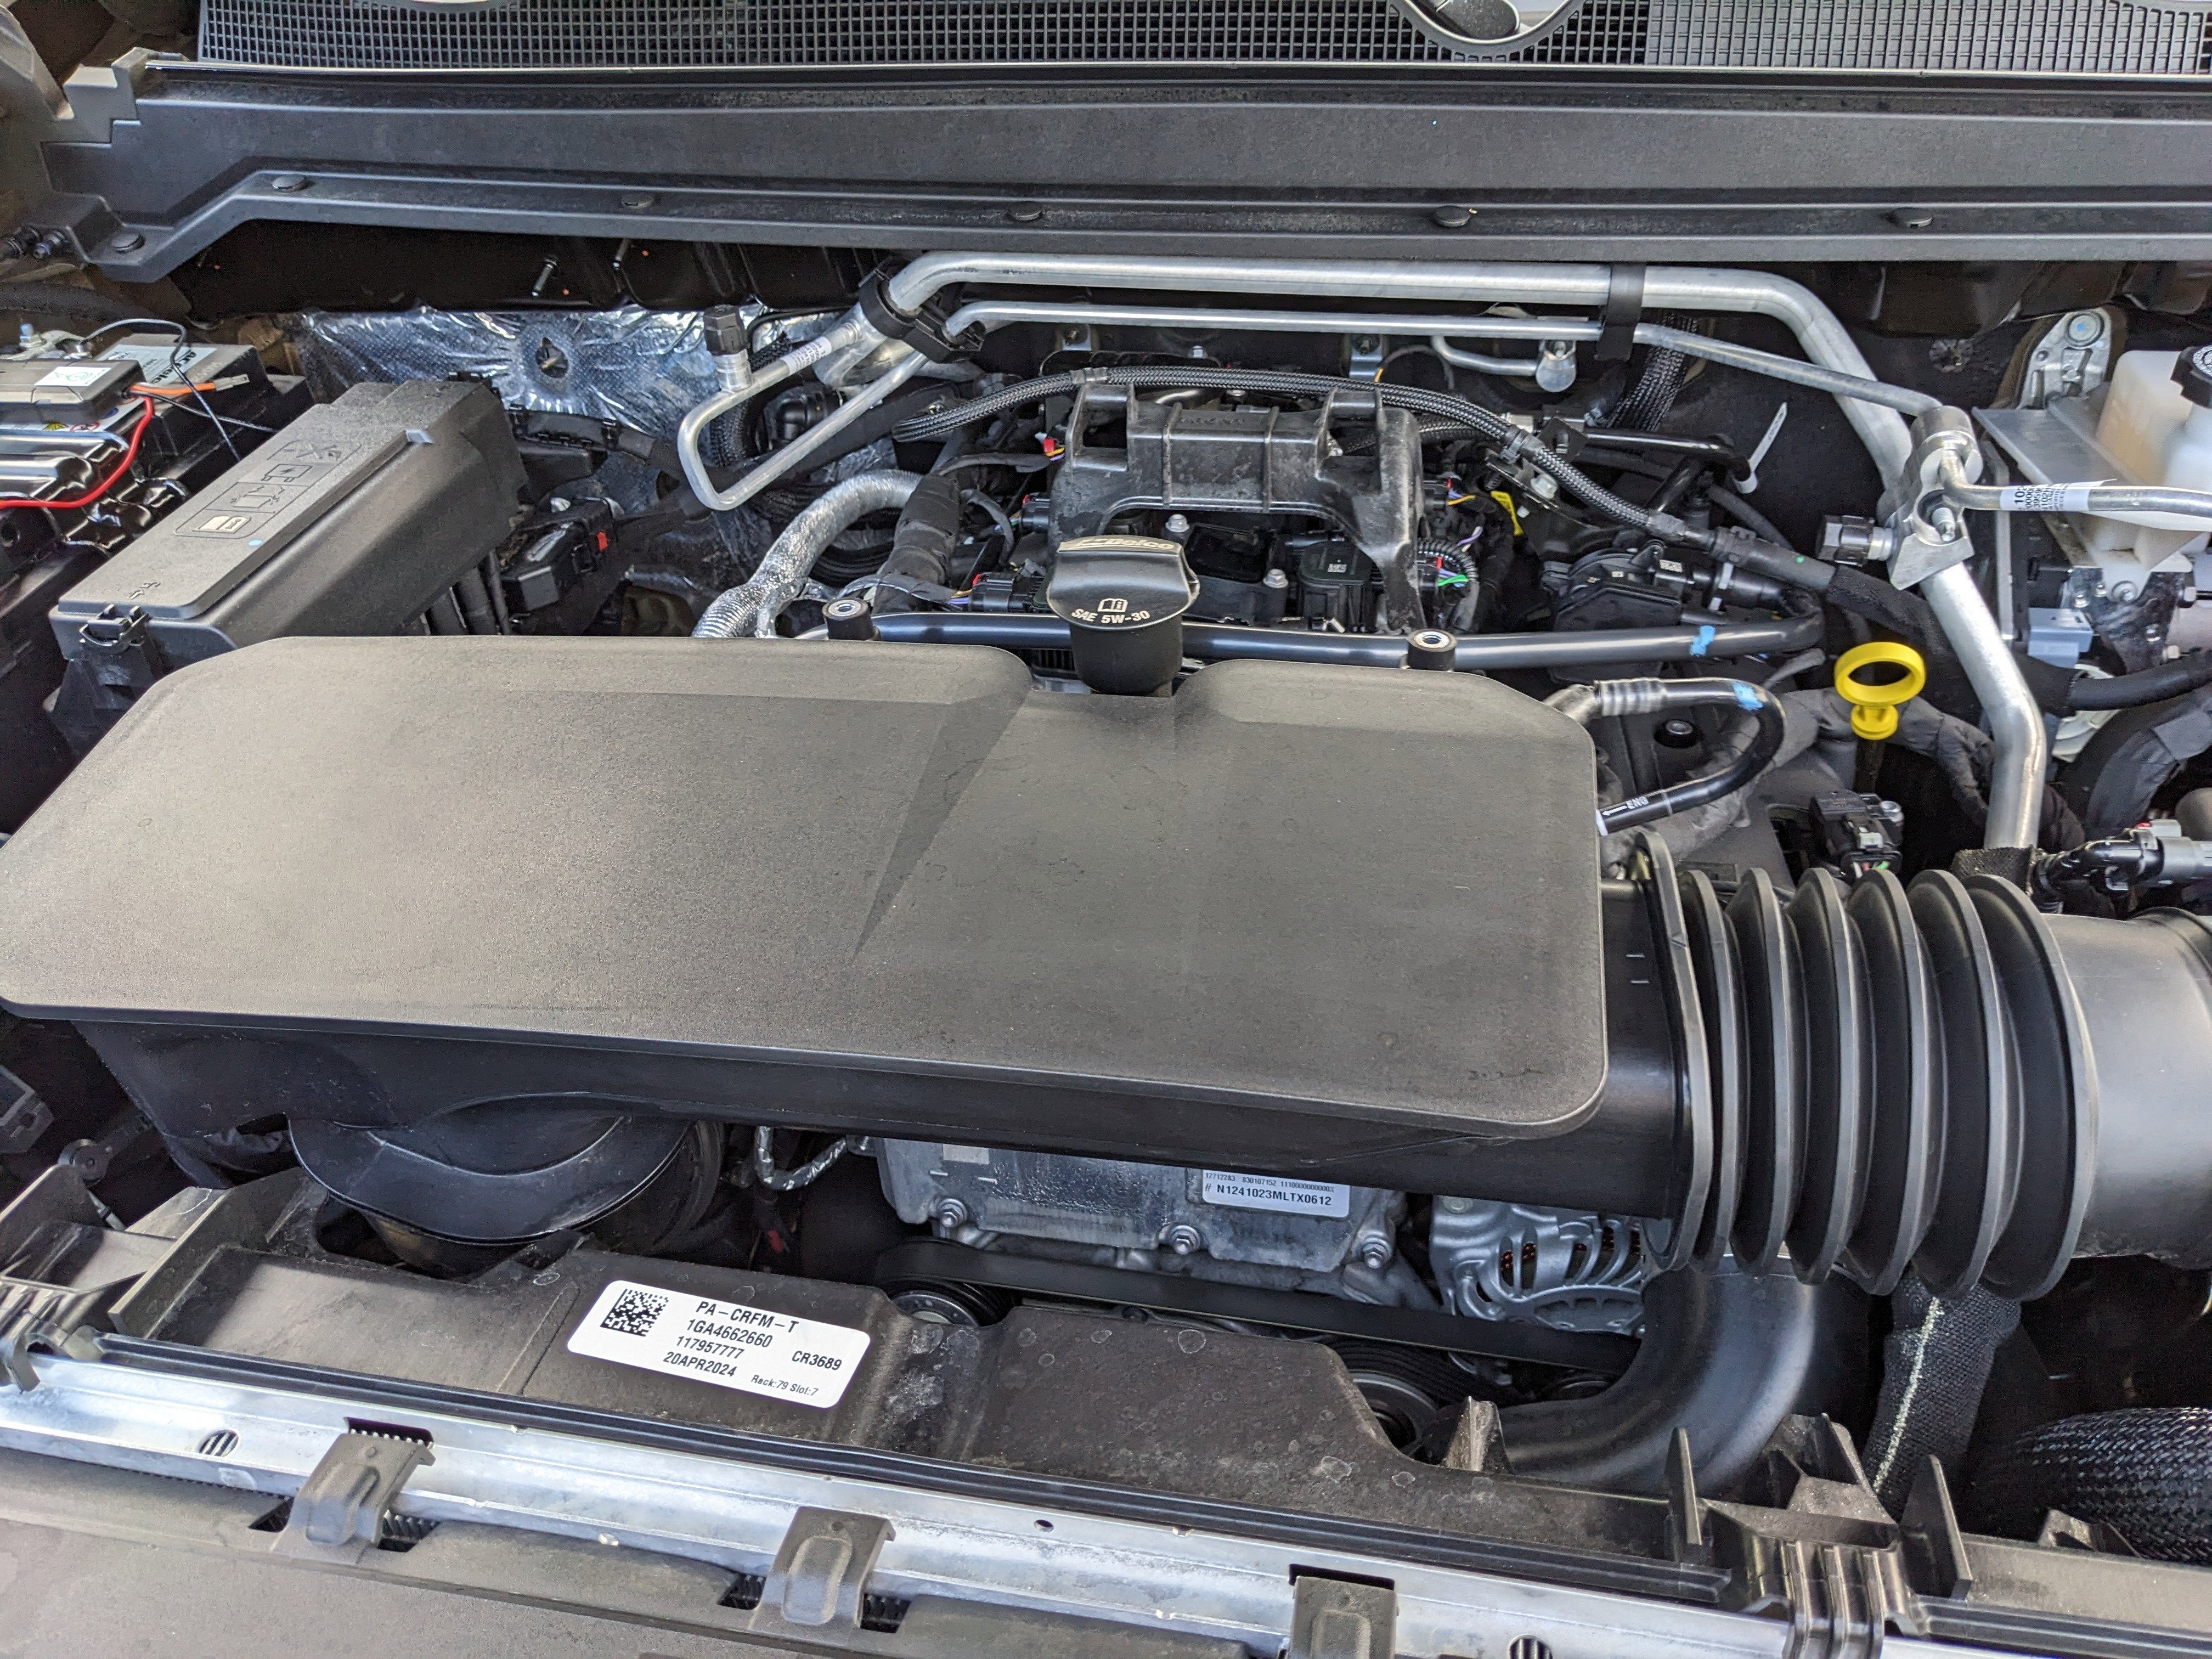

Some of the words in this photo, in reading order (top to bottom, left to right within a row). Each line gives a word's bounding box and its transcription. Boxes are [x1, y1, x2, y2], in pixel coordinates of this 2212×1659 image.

[1071, 608, 1098, 622] SAE
[1101, 610, 1151, 624] 5W-30
[1626, 796, 1649, 809] ENG
[1216, 1184, 1332, 1206] N1241023MLTX0612
[687, 1318, 773, 1348] 1GA4662660
[676, 1335, 745, 1359] 117957777
[663, 1351, 737, 1377] 20APR2024
[792, 1350, 842, 1370] CR3689
[751, 1374, 789, 1390] Rack:79
[789, 1383, 819, 1396] Slot:7
